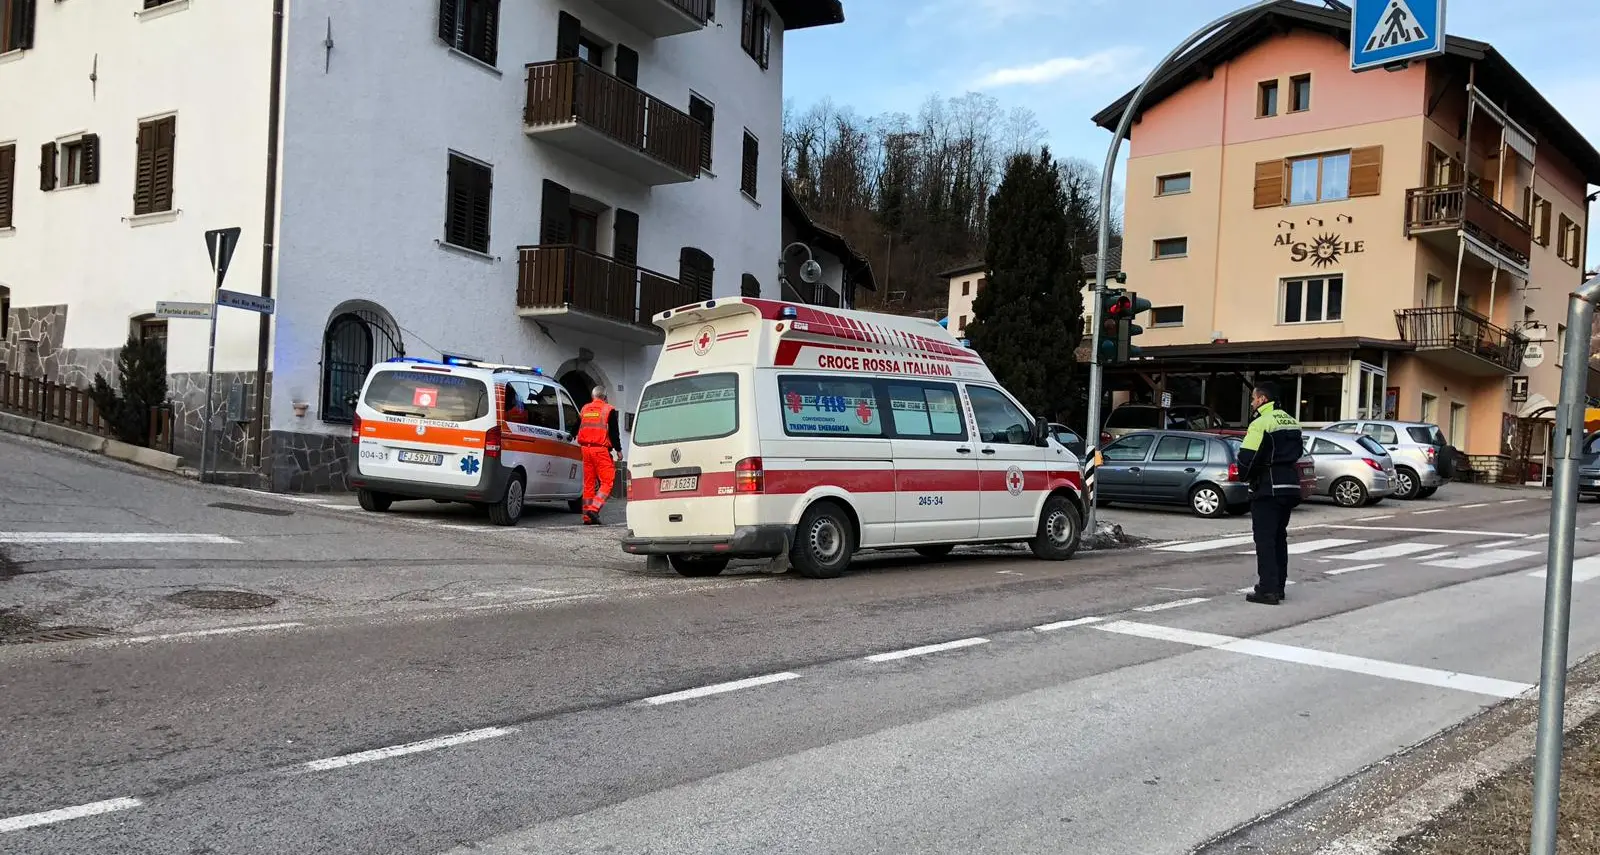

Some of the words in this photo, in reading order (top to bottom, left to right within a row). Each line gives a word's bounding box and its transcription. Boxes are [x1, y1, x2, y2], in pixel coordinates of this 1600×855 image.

[1274, 233, 1295, 246] AL
[818, 354, 859, 370] CROCE
[862, 358, 901, 373] ROSSA
[903, 361, 952, 376] ITALIANA
[386, 416, 418, 425] TRENTINO
[419, 419, 459, 428] EMERGENZA
[789, 423, 817, 431] TRENTINO
[818, 424, 850, 432] EMERGENZA
[360, 450, 389, 460] 004-31
[918, 496, 943, 506] 245-34
